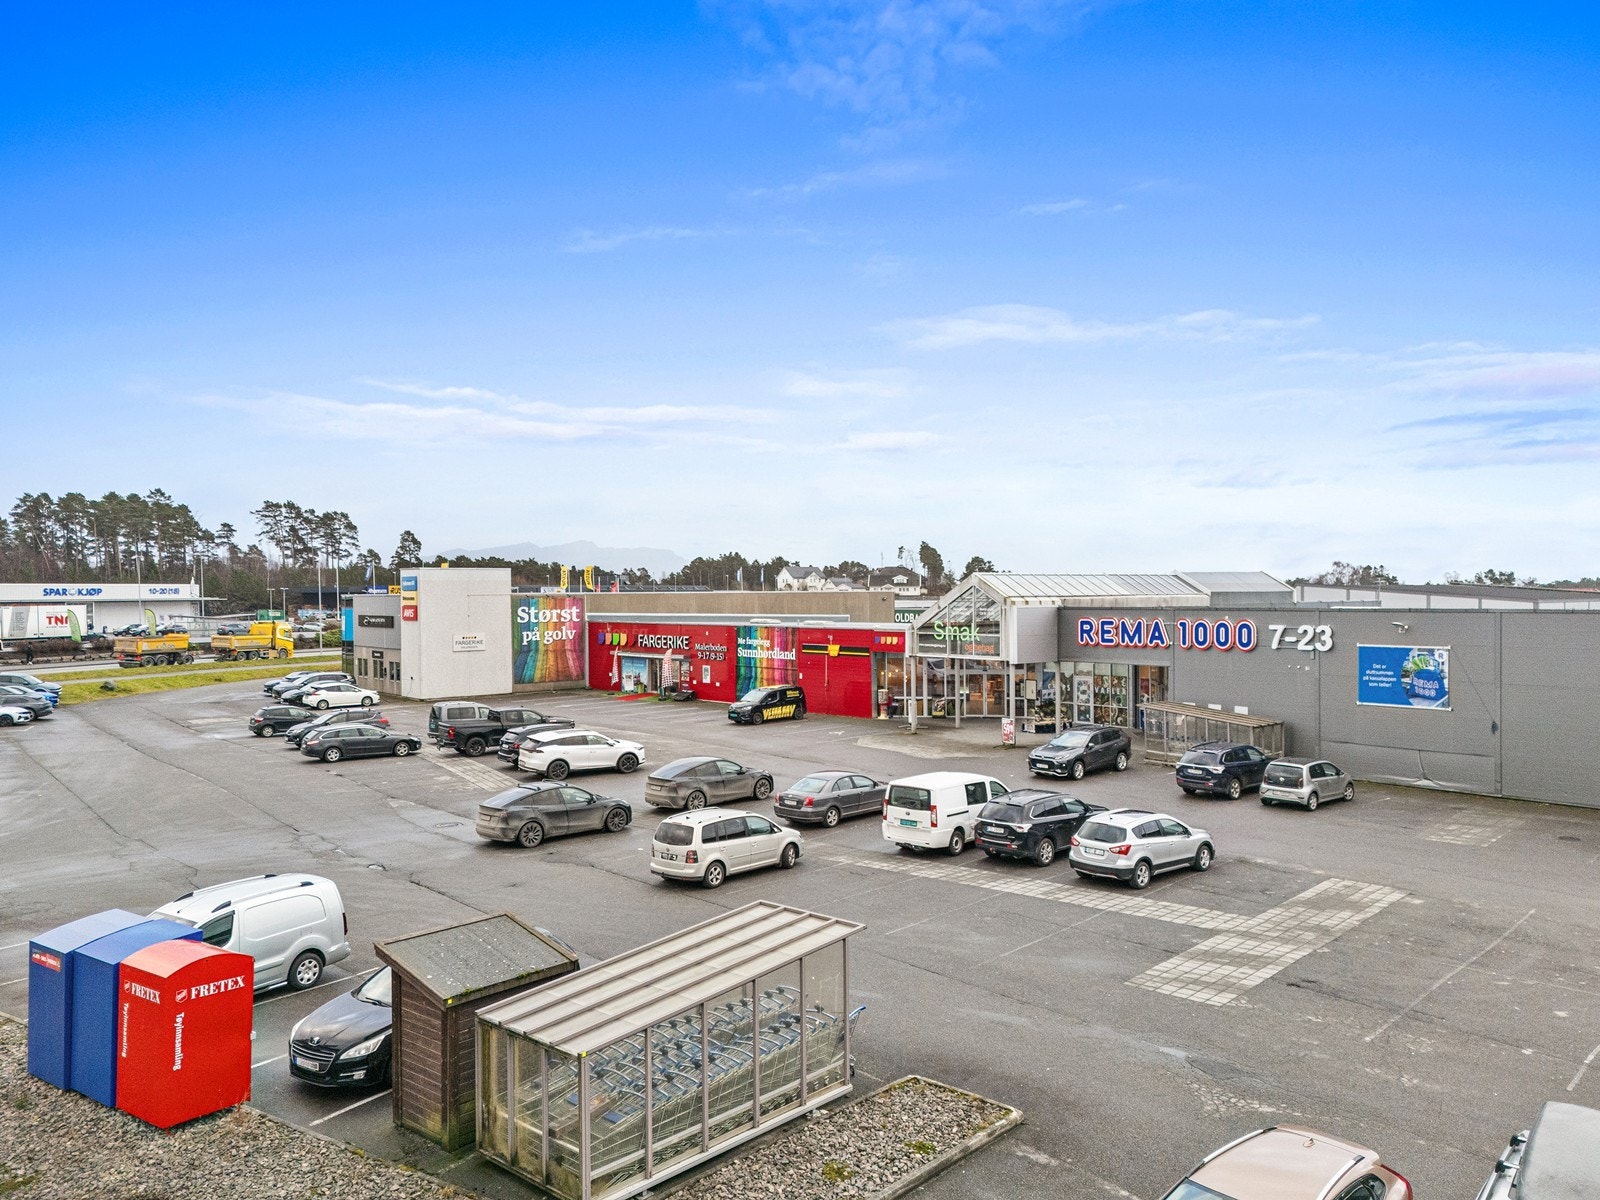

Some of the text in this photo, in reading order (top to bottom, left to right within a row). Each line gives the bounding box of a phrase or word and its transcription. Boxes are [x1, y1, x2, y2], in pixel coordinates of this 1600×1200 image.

[43, 587, 103, 597] SPAR KJØP
[403, 608, 415, 618] AVIS
[517, 605, 581, 623] Størst
[521, 627, 541, 645] på
[543, 626, 577, 645] golv
[933, 620, 981, 642] Smak
[1077, 616, 1257, 653] REMA 1000
[1268, 624, 1333, 652] 7-23
[637, 634, 690, 650] FARGERIKE
[694, 643, 728, 653] Malerboden
[737, 647, 797, 661] Sunnhordland
[130, 982, 161, 1004] FRETEX
[190, 975, 245, 1000] FRETEX
[172, 1011, 185, 1072] Tøyinnsamling
